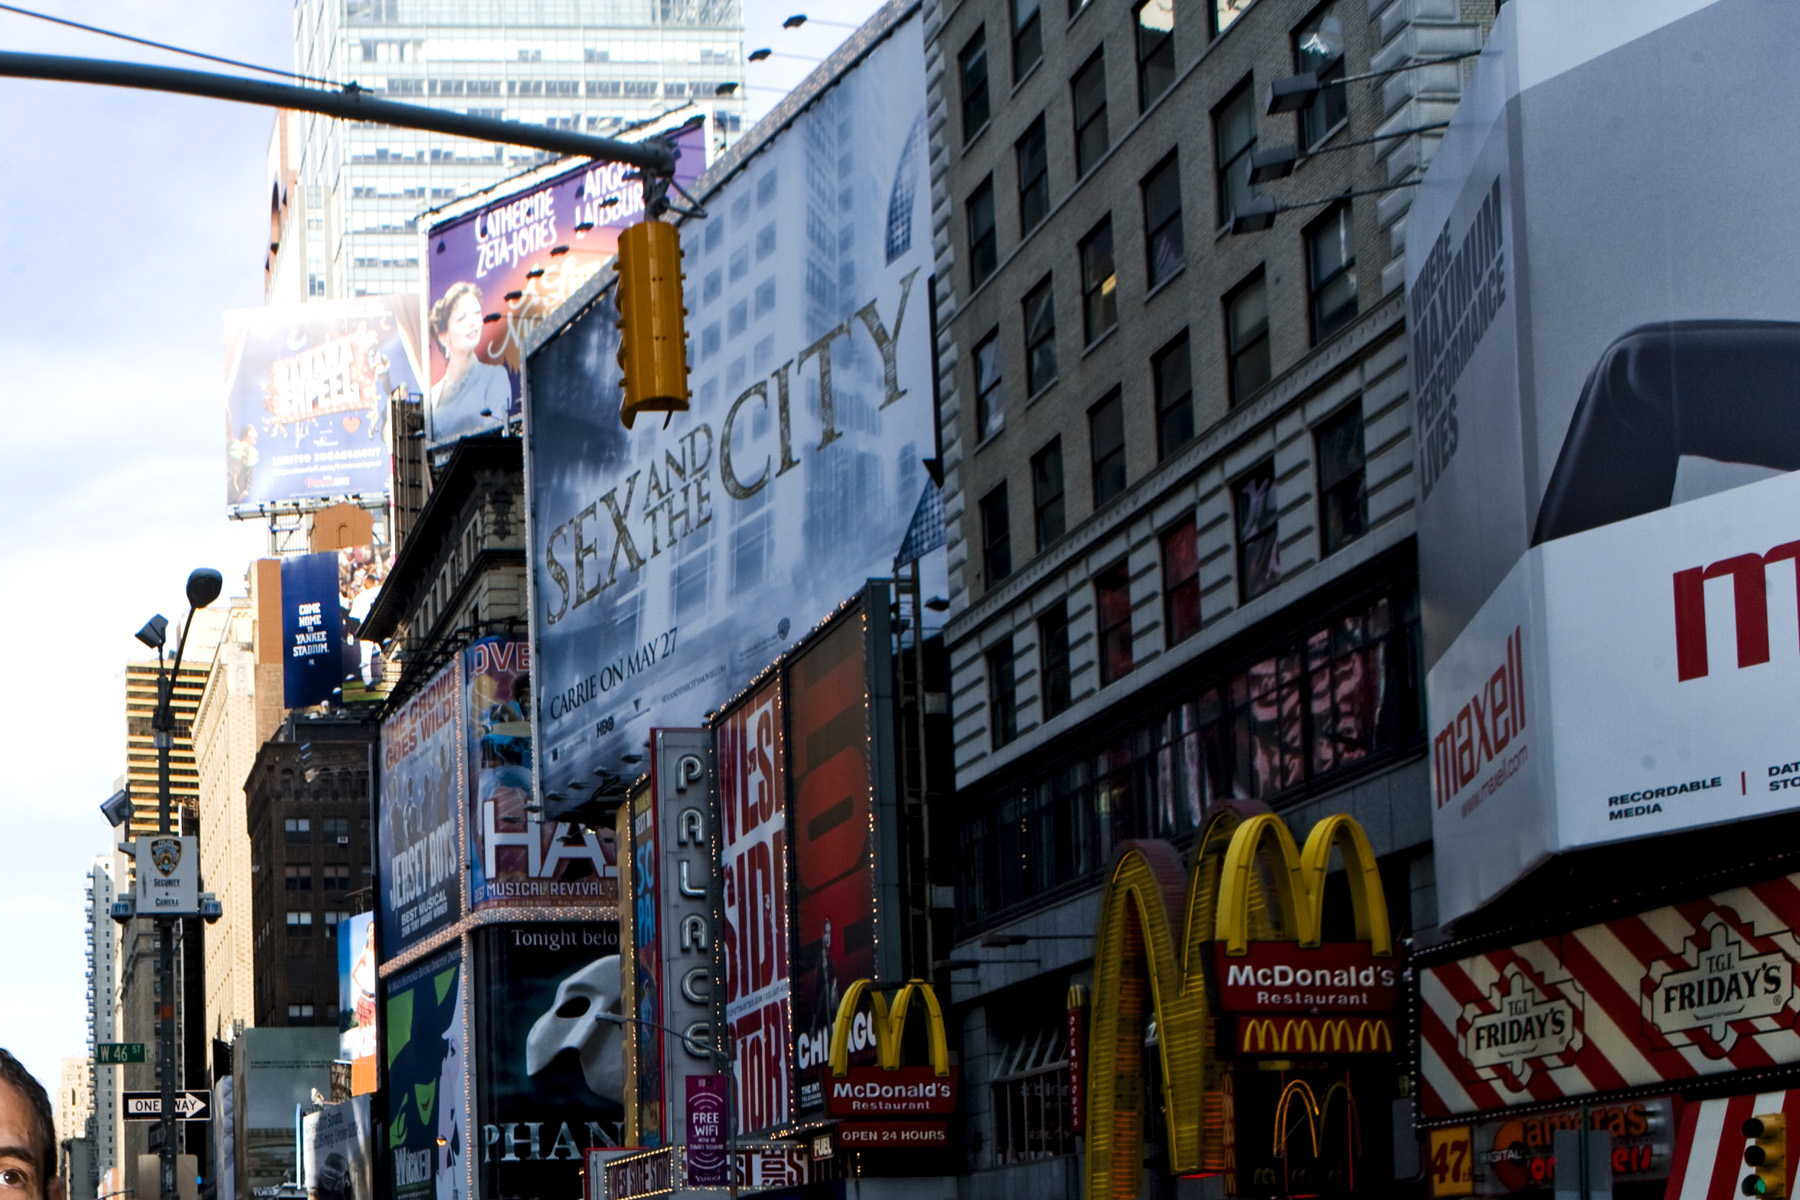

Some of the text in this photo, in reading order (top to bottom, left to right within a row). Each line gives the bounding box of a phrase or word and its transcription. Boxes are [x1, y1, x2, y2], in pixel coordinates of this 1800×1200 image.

[475, 187, 555, 243] CATHERINE
[476, 215, 558, 281] ZETA-JONES
[1410, 215, 1451, 330] WHERE
[1413, 174, 1504, 398] MAXIMUM
[1416, 250, 1506, 445] PERFORMANCE
[720, 265, 923, 503] CITY
[1419, 392, 1459, 503] LIVES
[641, 422, 715, 503] AND
[544, 468, 713, 625] SEX THE
[298, 601, 321, 616] COME
[298, 613, 322, 628] HOME
[294, 630, 328, 645] YANKEE
[549, 626, 679, 721] CARRIE ON MAY 27
[595, 714, 615, 739] HBO
[1433, 624, 1527, 811] maxell
[385, 730, 418, 773] GOES
[1459, 744, 1529, 819] www.maxell.com
[1767, 761, 1800, 778] DAT
[1607, 776, 1723, 808] RECORDABLE
[1608, 802, 1663, 821] MEDIA
[389, 819, 458, 912] JERSEY BOYS
[153, 878, 181, 888] SECURITY
[486, 882, 547, 897] MUSICAL
[550, 882, 606, 896] REVIVAL
[155, 897, 180, 907] CAMERA
[400, 888, 448, 927] BEST MUSICAL
[674, 753, 712, 1060] PALACE
[510, 928, 579, 952] Tonight
[1705, 953, 1735, 973] T.G.I.
[1227, 964, 1395, 989] McDonald's
[1663, 963, 1782, 1015] FRIDAY'S
[1256, 990, 1369, 1006] Restaurant
[1506, 999, 1530, 1017] T.G.I.
[797, 1010, 877, 1071] CHIAGO
[1068, 1016, 1079, 1059] OPEN
[1475, 1008, 1565, 1051] FRIDAY'S
[99, 1044, 142, 1062] W 46 ST
[832, 1081, 951, 1099] McDonald's
[134, 1100, 161, 1113] ONE
[692, 1111, 720, 1125] FREE
[851, 1099, 931, 1112] Restaurant
[694, 1124, 719, 1137] WIFI
[841, 1129, 946, 1142] OPEN 24 HOURS
[813, 1136, 832, 1157] FUEL
